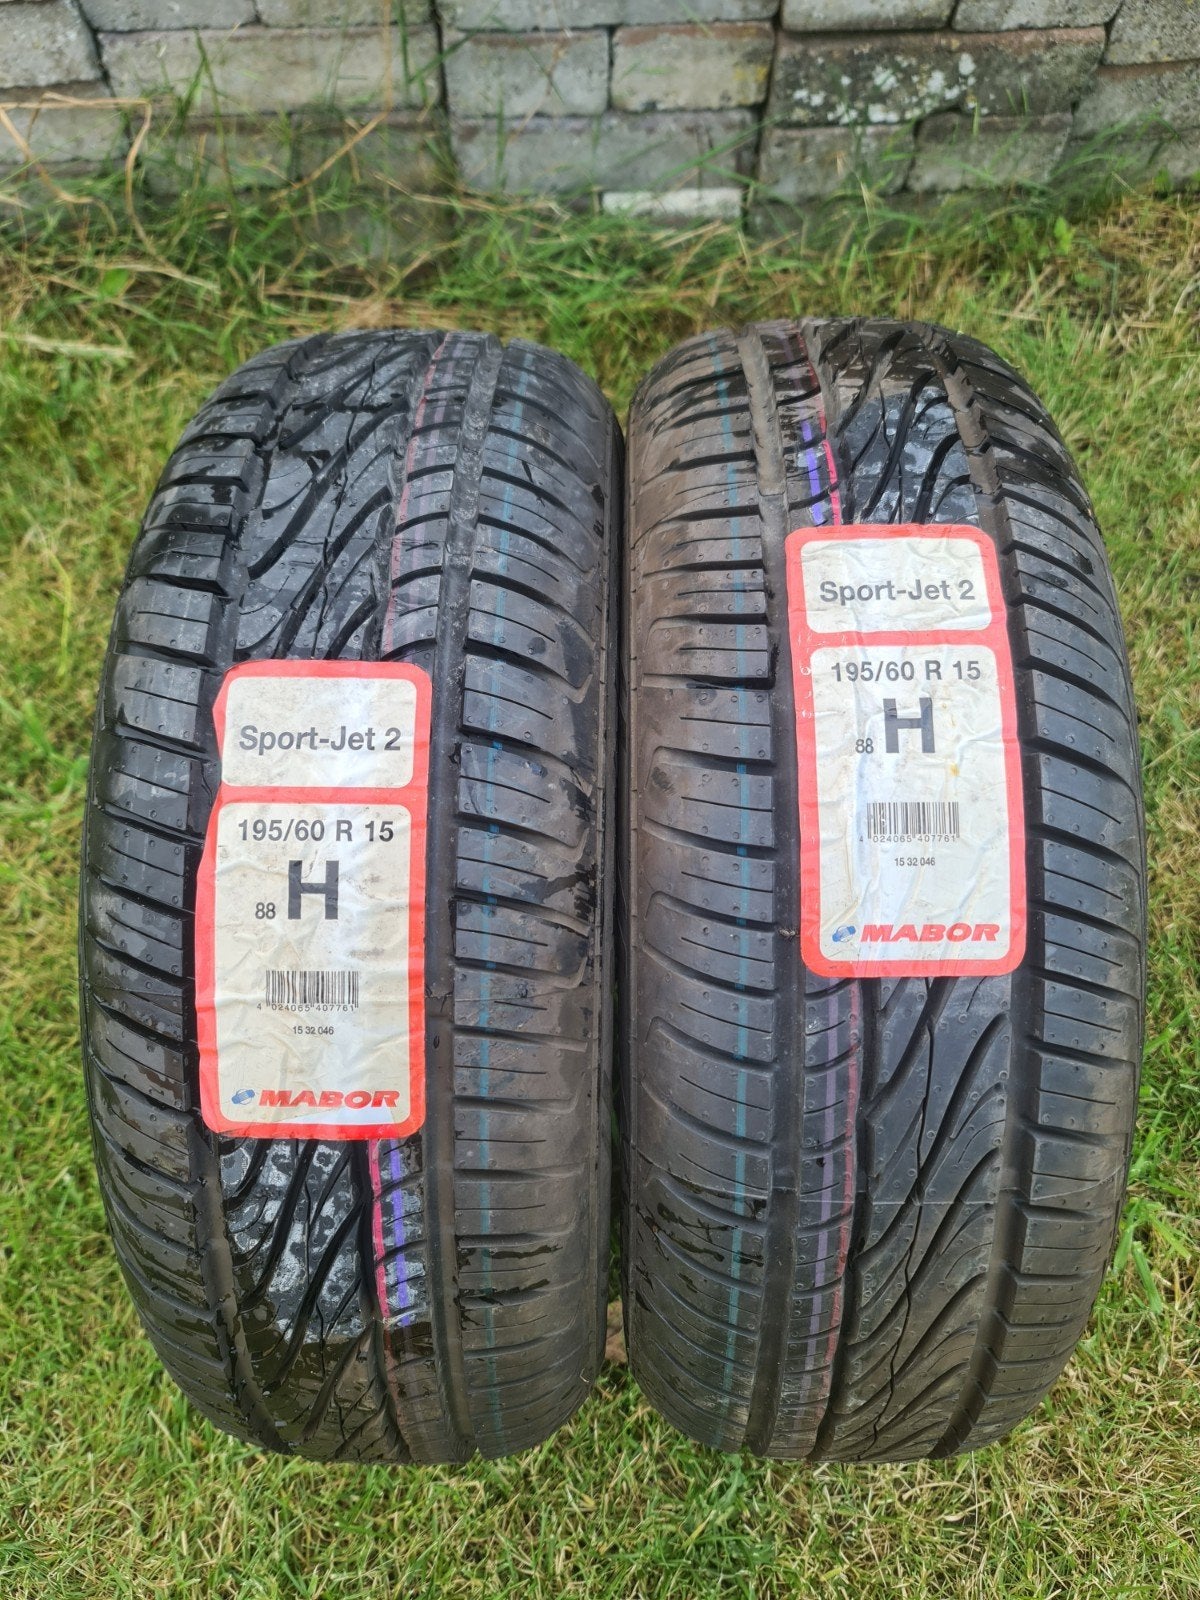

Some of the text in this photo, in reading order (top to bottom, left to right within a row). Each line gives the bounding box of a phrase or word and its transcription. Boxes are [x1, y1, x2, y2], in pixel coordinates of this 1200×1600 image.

[819, 579, 976, 606] Sport-Jet 2
[831, 660, 981, 682] 195/60 R 15
[855, 697, 936, 754] 88 H
[239, 724, 402, 756] Sport-Jet 2
[238, 818, 394, 842] 195/60 R 15
[255, 859, 339, 920] 88 H
[861, 922, 1001, 943] MABOR
[259, 1089, 400, 1109] MABOR
